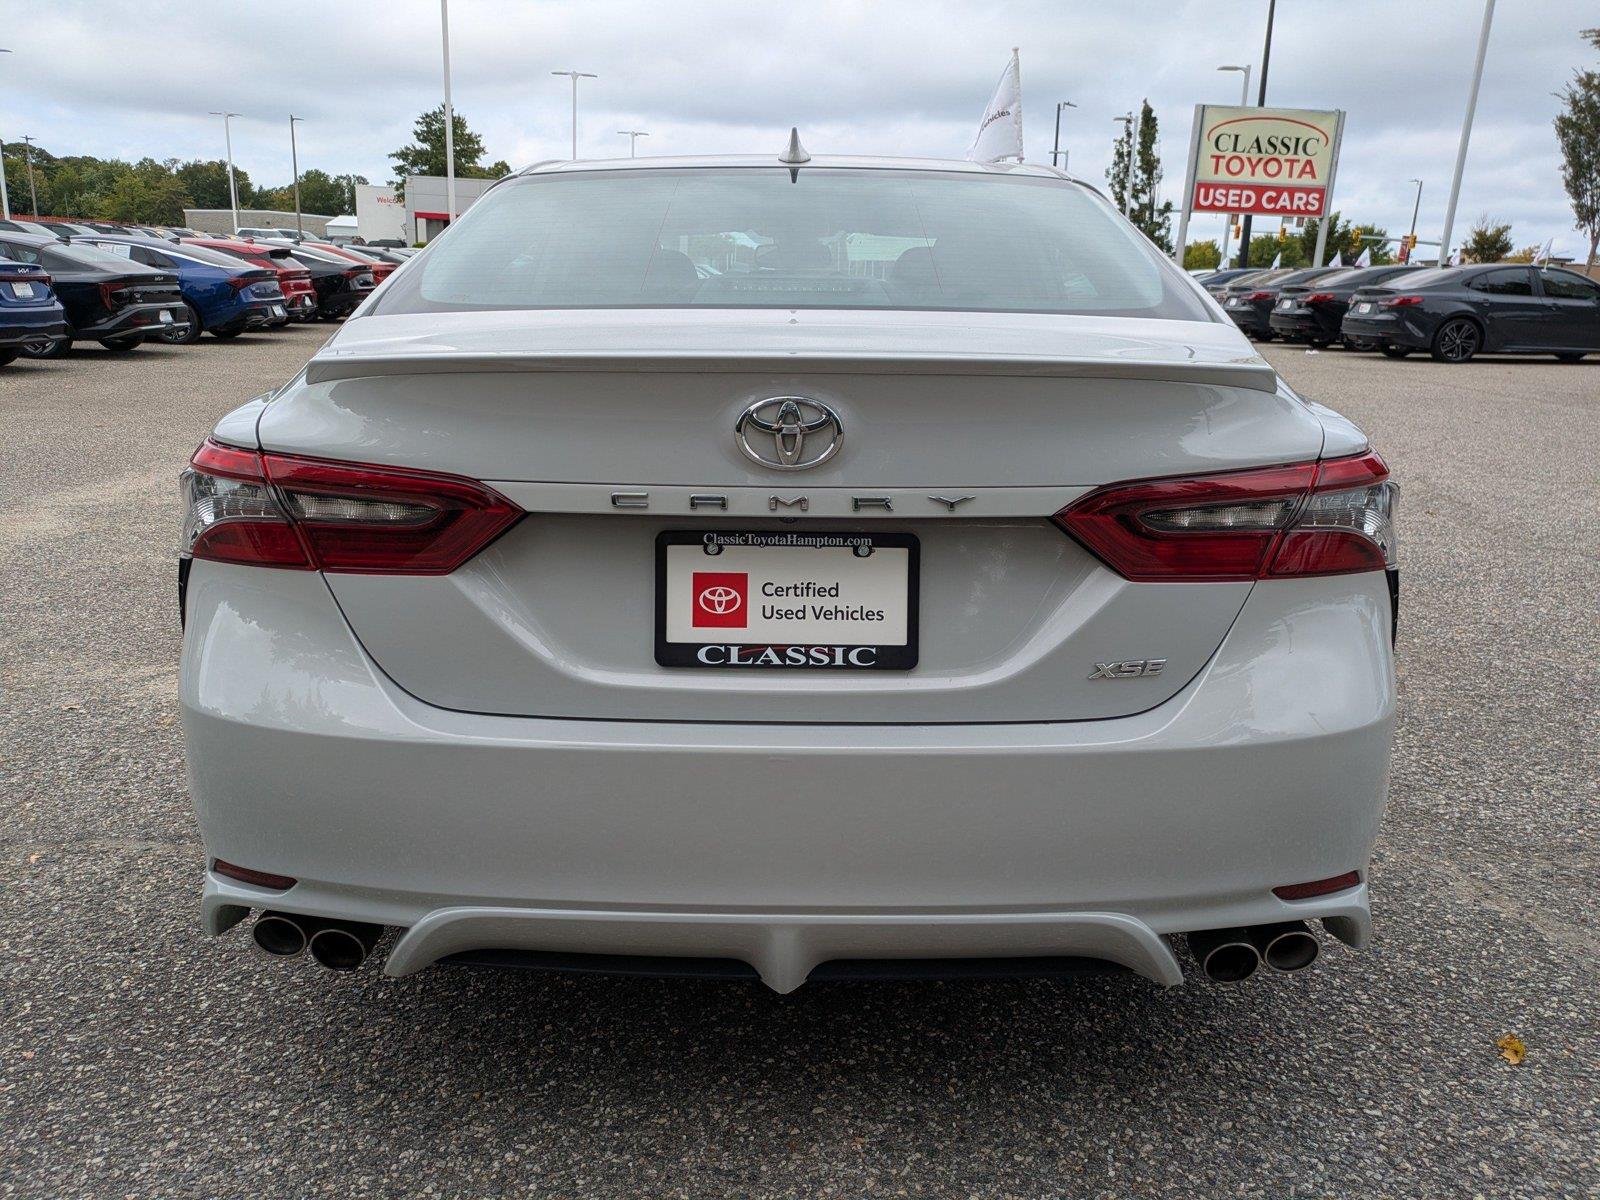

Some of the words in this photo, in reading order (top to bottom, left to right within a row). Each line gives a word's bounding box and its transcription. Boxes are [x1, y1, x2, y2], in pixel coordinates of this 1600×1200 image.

[1214, 133, 1320, 157] CLASSIC
[1210, 154, 1317, 180] TOYOTA
[1199, 188, 1256, 208] USED
[1261, 191, 1321, 212] CARS
[611, 492, 976, 512] CAMRY
[703, 532, 873, 548] ClassicToyotaHampton.com
[761, 582, 839, 598] Certified
[761, 605, 806, 621] Used
[811, 605, 885, 622] Vehicles
[697, 645, 877, 666] CLASSIC
[1088, 658, 1167, 679] XSE
